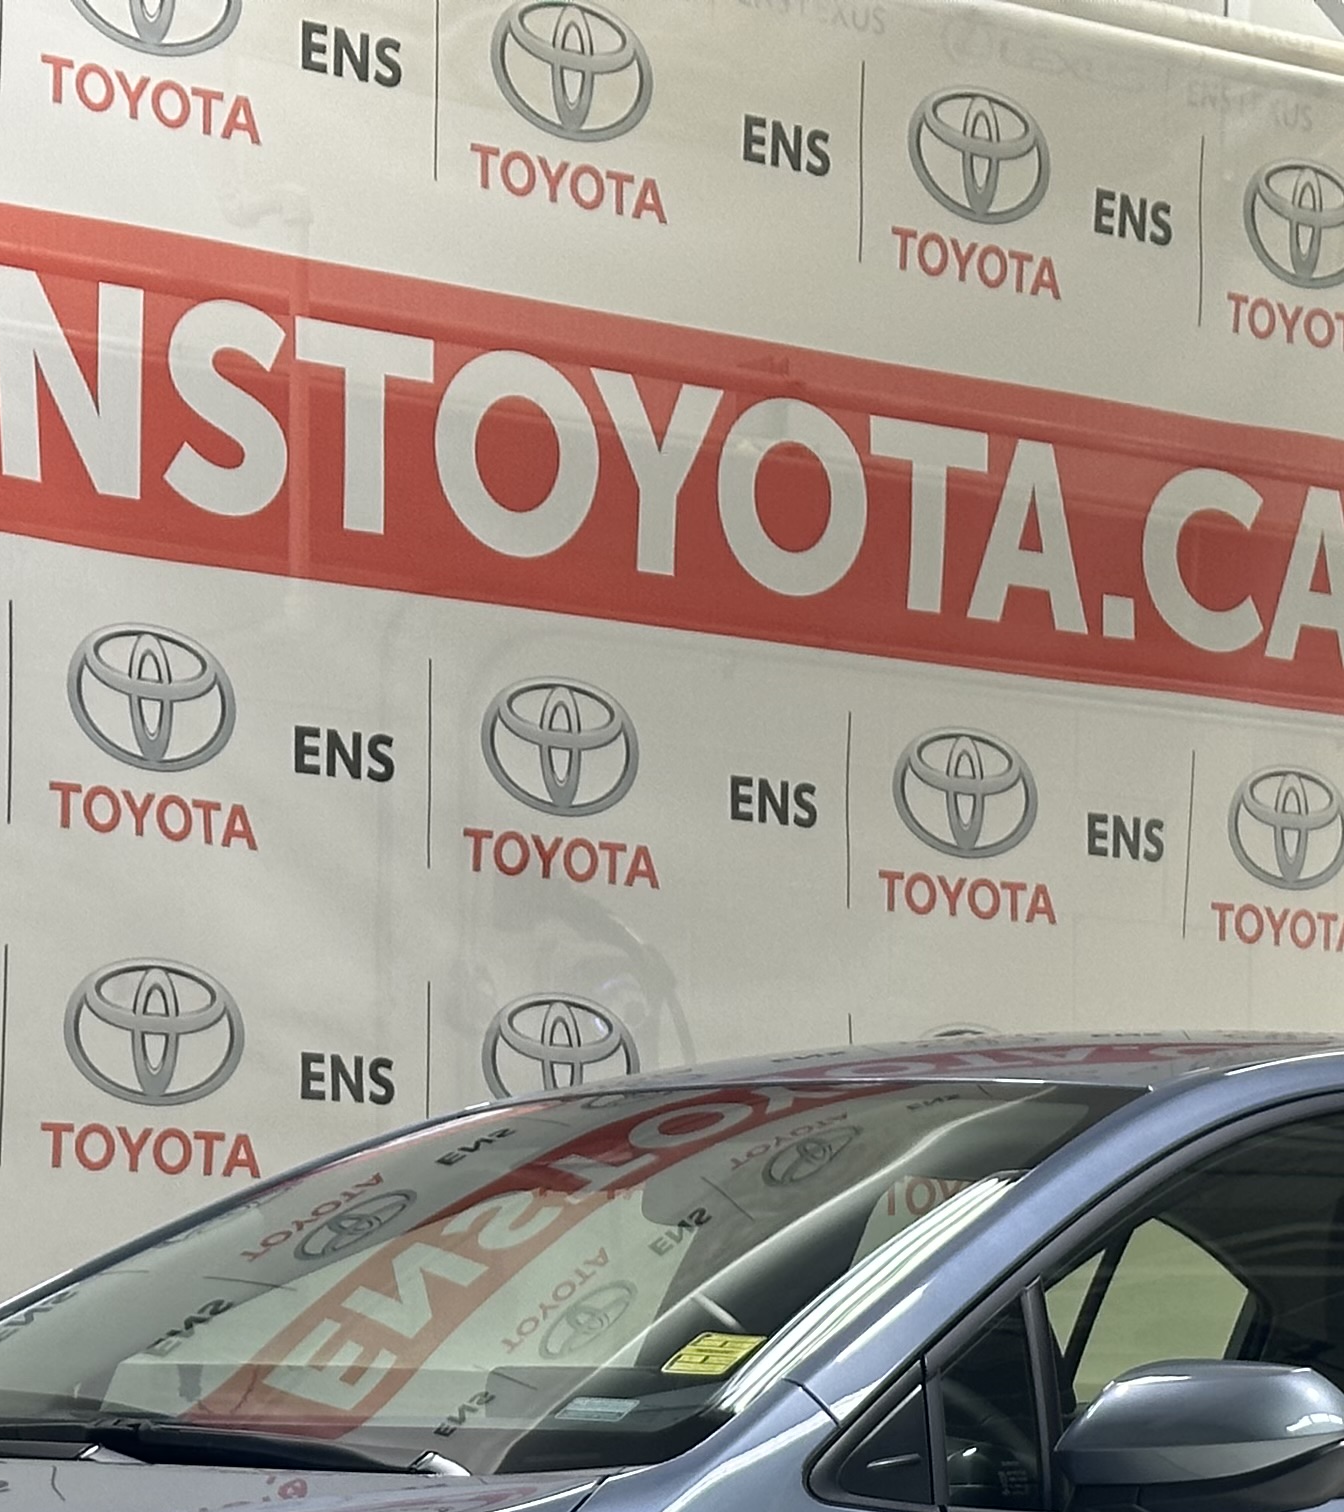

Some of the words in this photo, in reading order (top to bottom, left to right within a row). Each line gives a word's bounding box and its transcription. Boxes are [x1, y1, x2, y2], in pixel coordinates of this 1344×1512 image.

[301, 20, 402, 88] ENS
[40, 54, 262, 146] TOYOTA
[742, 114, 830, 177] ENS
[470, 143, 668, 225] TOYOTA
[1093, 187, 1173, 246] ENS
[891, 226, 1061, 301] TOYOTA
[293, 725, 396, 783] ENS
[49, 781, 258, 851] TOYOTA
[729, 774, 817, 828] ENS
[463, 827, 660, 890] TOYOTA
[1087, 812, 1164, 862] ENS
[878, 869, 1057, 925] TOYOTA
[299, 1052, 395, 1106] ENS
[41, 1122, 261, 1178] TOYOTA
